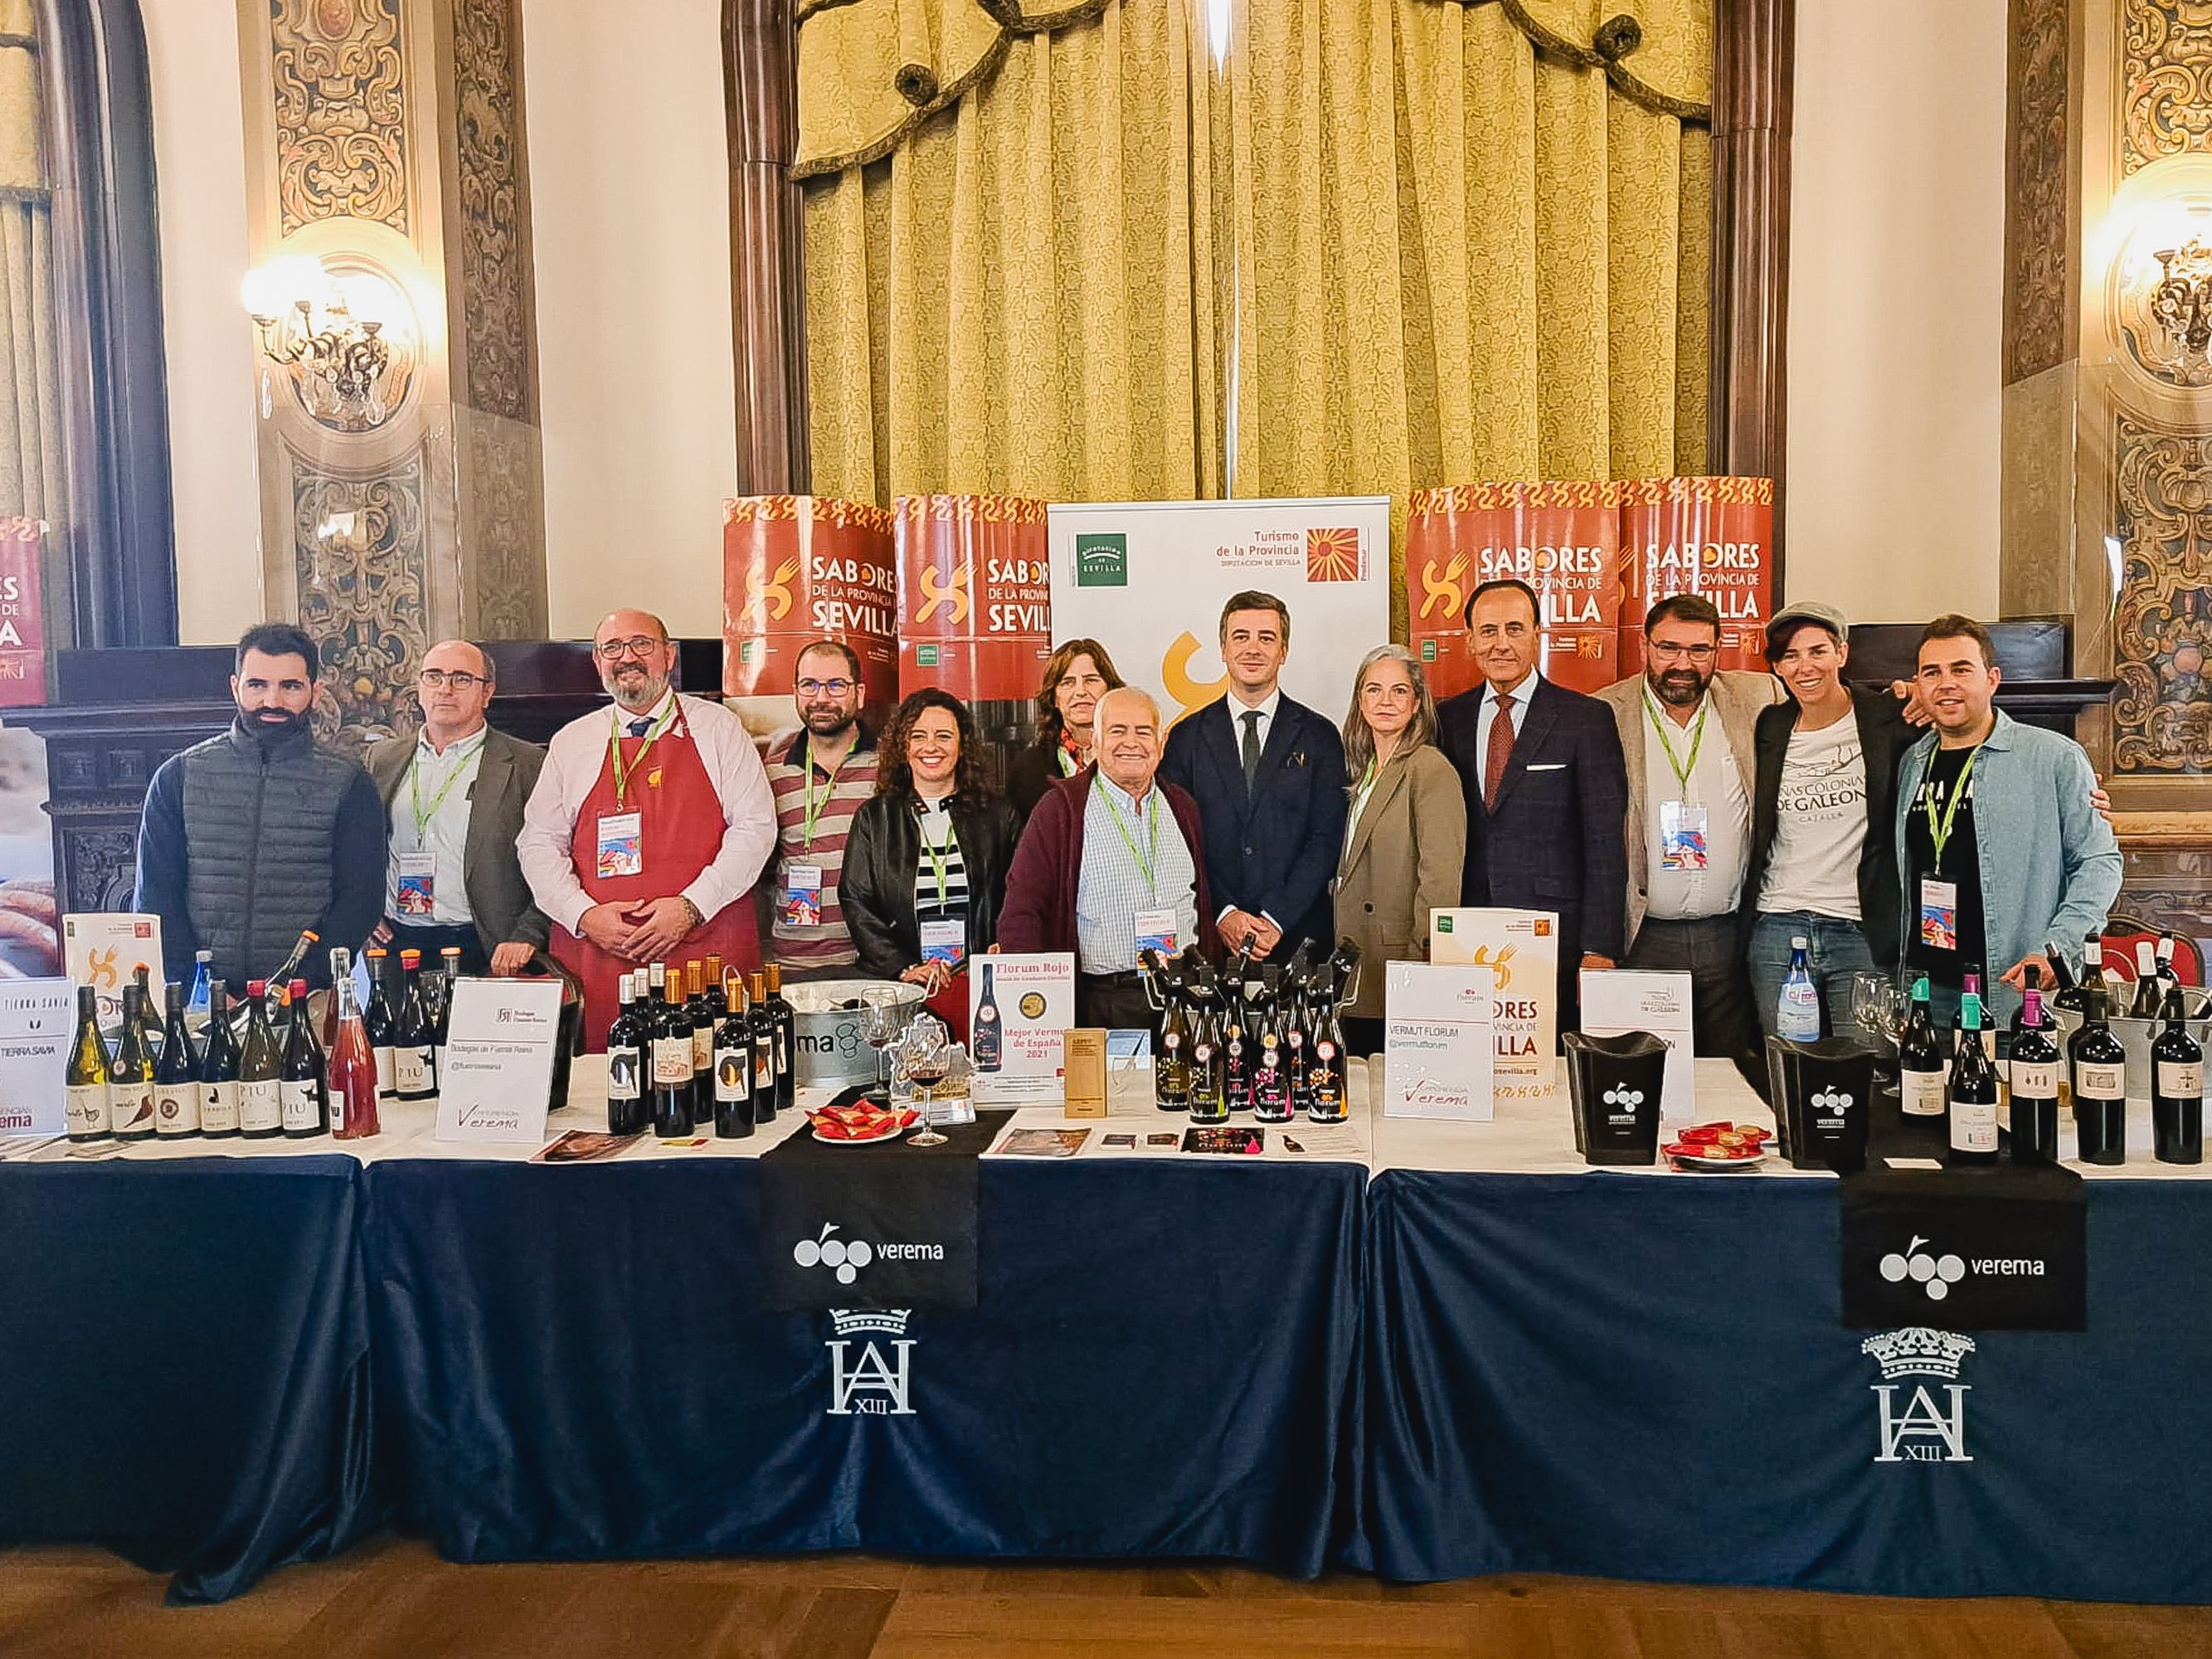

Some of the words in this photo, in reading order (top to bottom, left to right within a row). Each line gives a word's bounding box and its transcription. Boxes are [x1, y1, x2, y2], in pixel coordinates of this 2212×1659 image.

[1254, 530, 1300, 542] Turismo
[1216, 545, 1230, 557] de
[1234, 545, 1244, 557] la
[1249, 544, 1300, 556] Provincia
[1646, 542, 1760, 570] SABORES
[1480, 546, 1603, 574] SABORES
[1587, 577, 1602, 590] DE
[1646, 573, 1662, 586] DE
[1665, 573, 1682, 586] LA
[1747, 573, 1760, 586] DE
[812, 584, 829, 596] DE
[830, 586, 845, 597] LA
[988, 586, 1004, 600] DE
[1004, 587, 1018, 601] LA
[996, 962, 1039, 974] Florum
[1043, 962, 1070, 975] Rojo
[1004, 1029, 1031, 1038] Mejor
[1389, 1024, 1423, 1037] VERMUT
[1424, 1026, 1459, 1038] FLORUM
[1013, 1039, 1025, 1048] de
[1027, 1039, 1062, 1049] España
[1025, 1049, 1048, 1058] 2021
[877, 1243, 945, 1261] verema
[1971, 1258, 2045, 1276] verema
